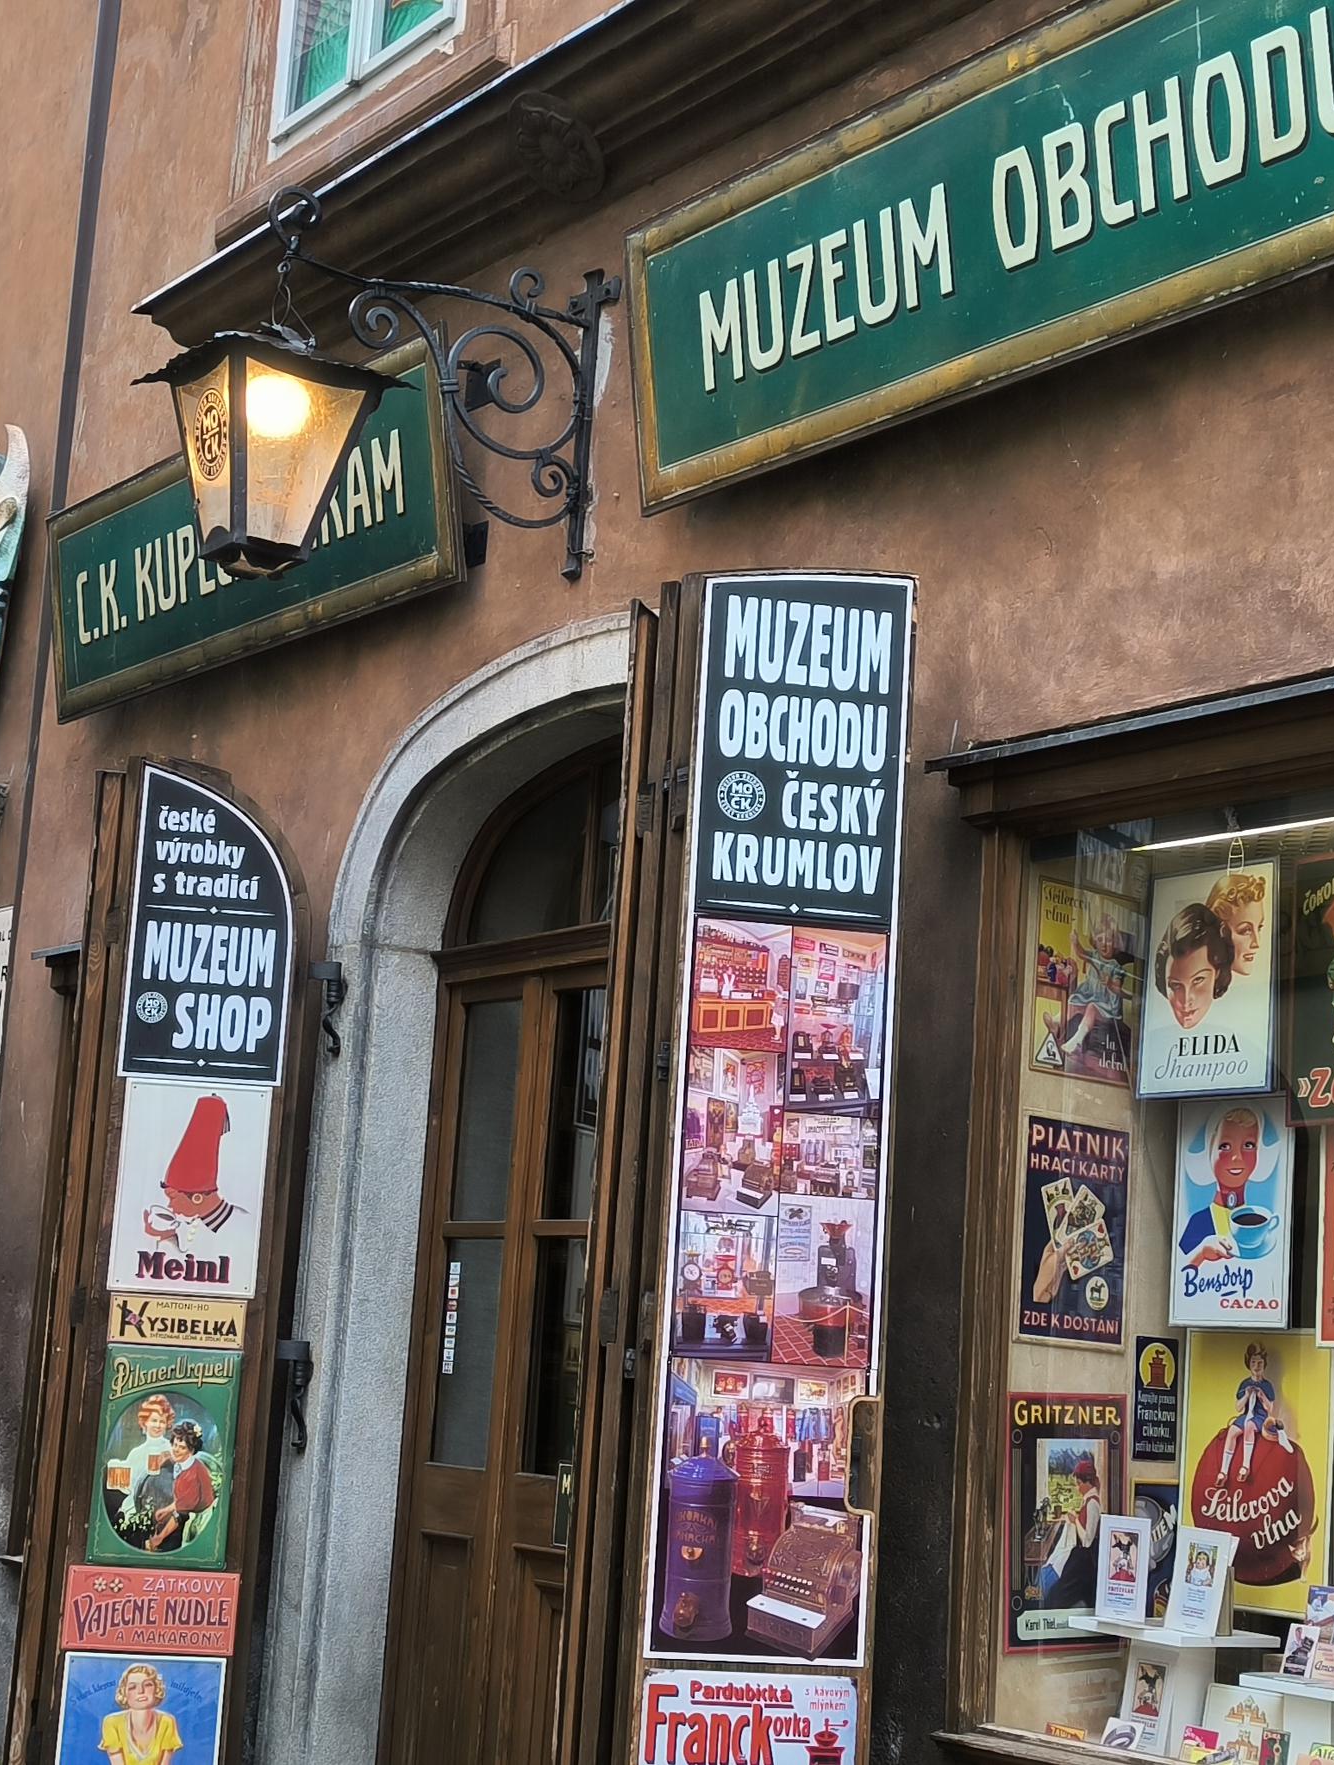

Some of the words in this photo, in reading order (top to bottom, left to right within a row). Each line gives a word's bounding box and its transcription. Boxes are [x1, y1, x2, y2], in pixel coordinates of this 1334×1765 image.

[698, 183, 955, 393] MUZEUM
[76, 559, 128, 645] C.K.
[724, 594, 893, 695] MUZEUM
[719, 689, 888, 772] OBCHODU
[158, 805, 217, 834] české
[782, 769, 886, 836] ČESKÝ
[155, 837, 245, 870] výrobky
[711, 831, 882, 896] KRUMLOV
[152, 872, 166, 894] s
[175, 870, 261, 901] tradicí
[142, 920, 277, 988] MUZEUM
[172, 992, 272, 1053] SHOP
[1178, 1033, 1241, 1058] ELIDA
[1154, 1043, 1249, 1083] Shampoo
[1031, 1124, 1126, 1161] PIATNIK
[1030, 1152, 1076, 1174] HRACÍ
[1079, 1161, 1126, 1183] KARTY
[135, 1250, 230, 1284] Meinl
[1181, 1264, 1253, 1298] Bensdorp
[119, 1300, 238, 1338] KYSIBELKA
[1220, 1298, 1280, 1310] CACAO
[1023, 1310, 1048, 1327] ZDE
[1051, 1313, 1061, 1329] K
[1063, 1315, 1120, 1336] DOSTÁNÍ
[110, 1356, 178, 1397] Pilsner
[175, 1354, 235, 1388] Urquell
[1013, 1400, 1121, 1426] GRITZNER
[1200, 1475, 1294, 1525] Seilerova
[1250, 1508, 1302, 1551] vlna
[142, 1576, 226, 1594] ZÁTKOVY
[164, 1599, 231, 1628] NUDLE
[116, 1630, 124, 1641] A
[690, 1680, 793, 1704] Pardubická
[804, 1688, 810, 1696] s
